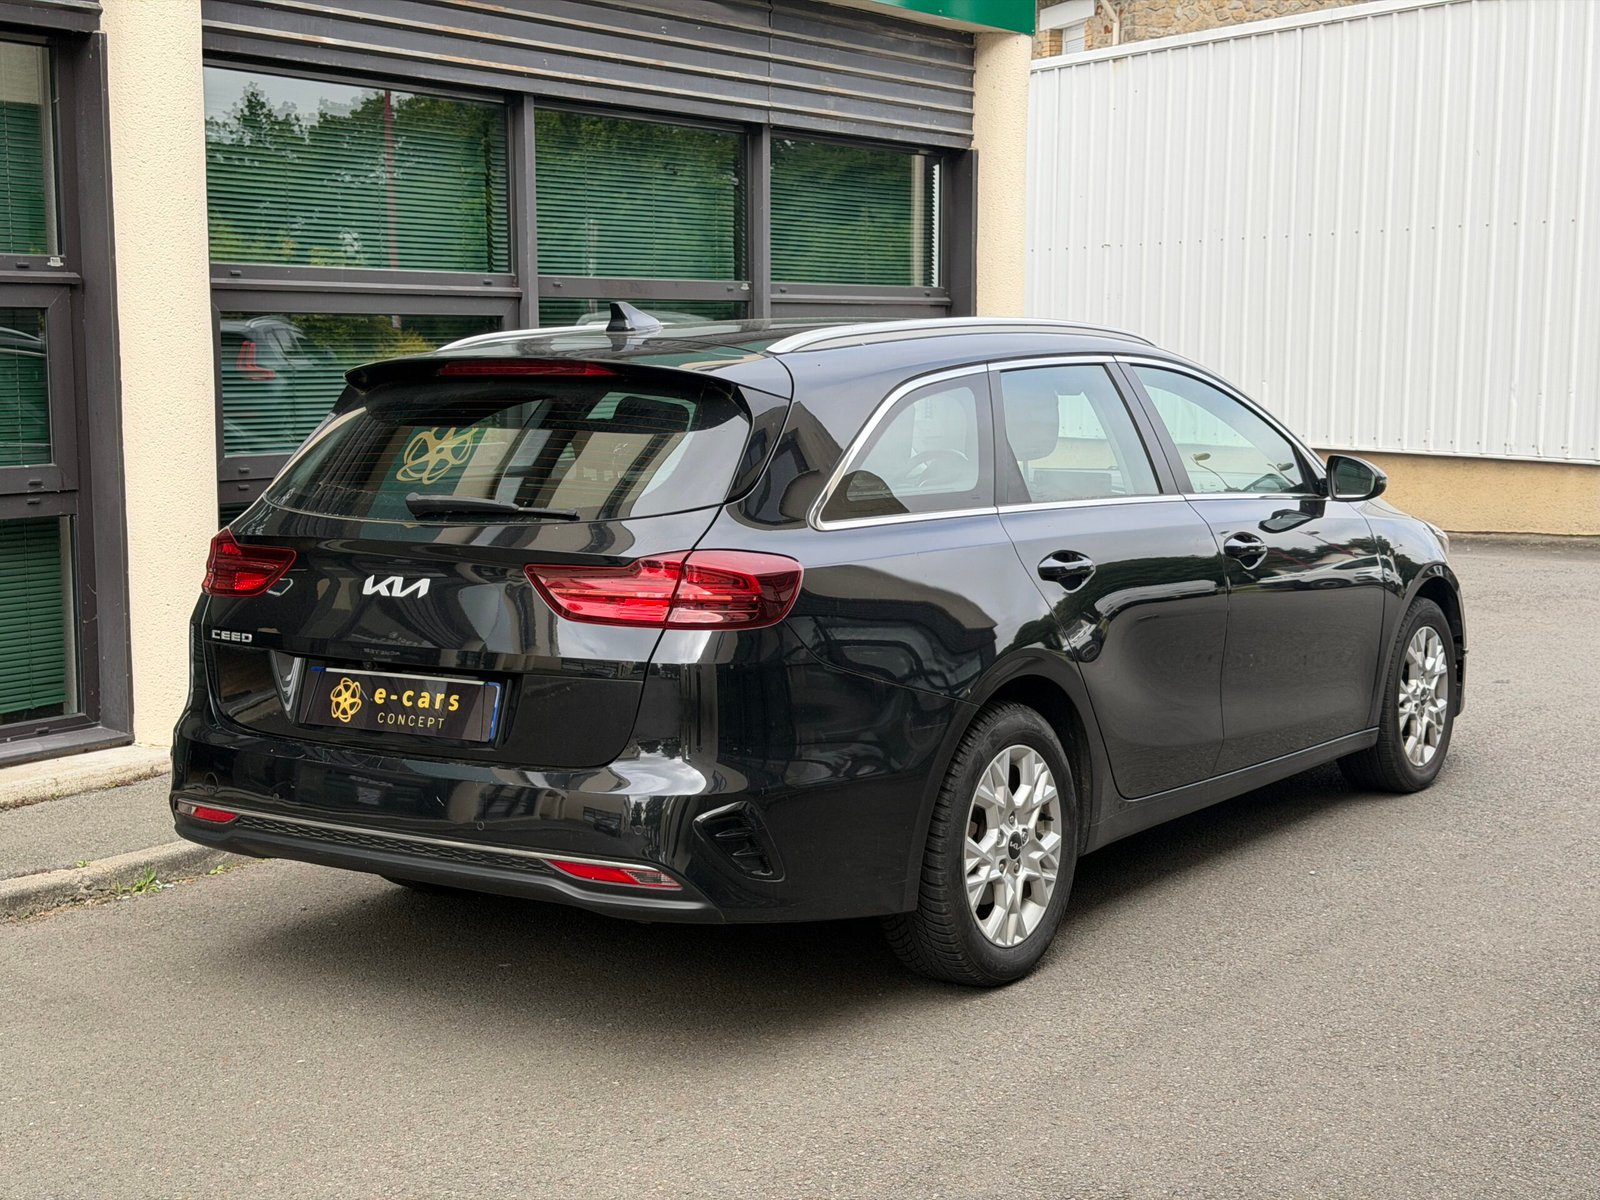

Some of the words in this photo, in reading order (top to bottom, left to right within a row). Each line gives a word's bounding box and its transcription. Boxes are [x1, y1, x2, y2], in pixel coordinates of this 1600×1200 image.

[362, 574, 431, 599] KIA
[211, 629, 253, 643] CEED
[374, 687, 460, 711] e-cars
[377, 712, 445, 729] CONCEPT
